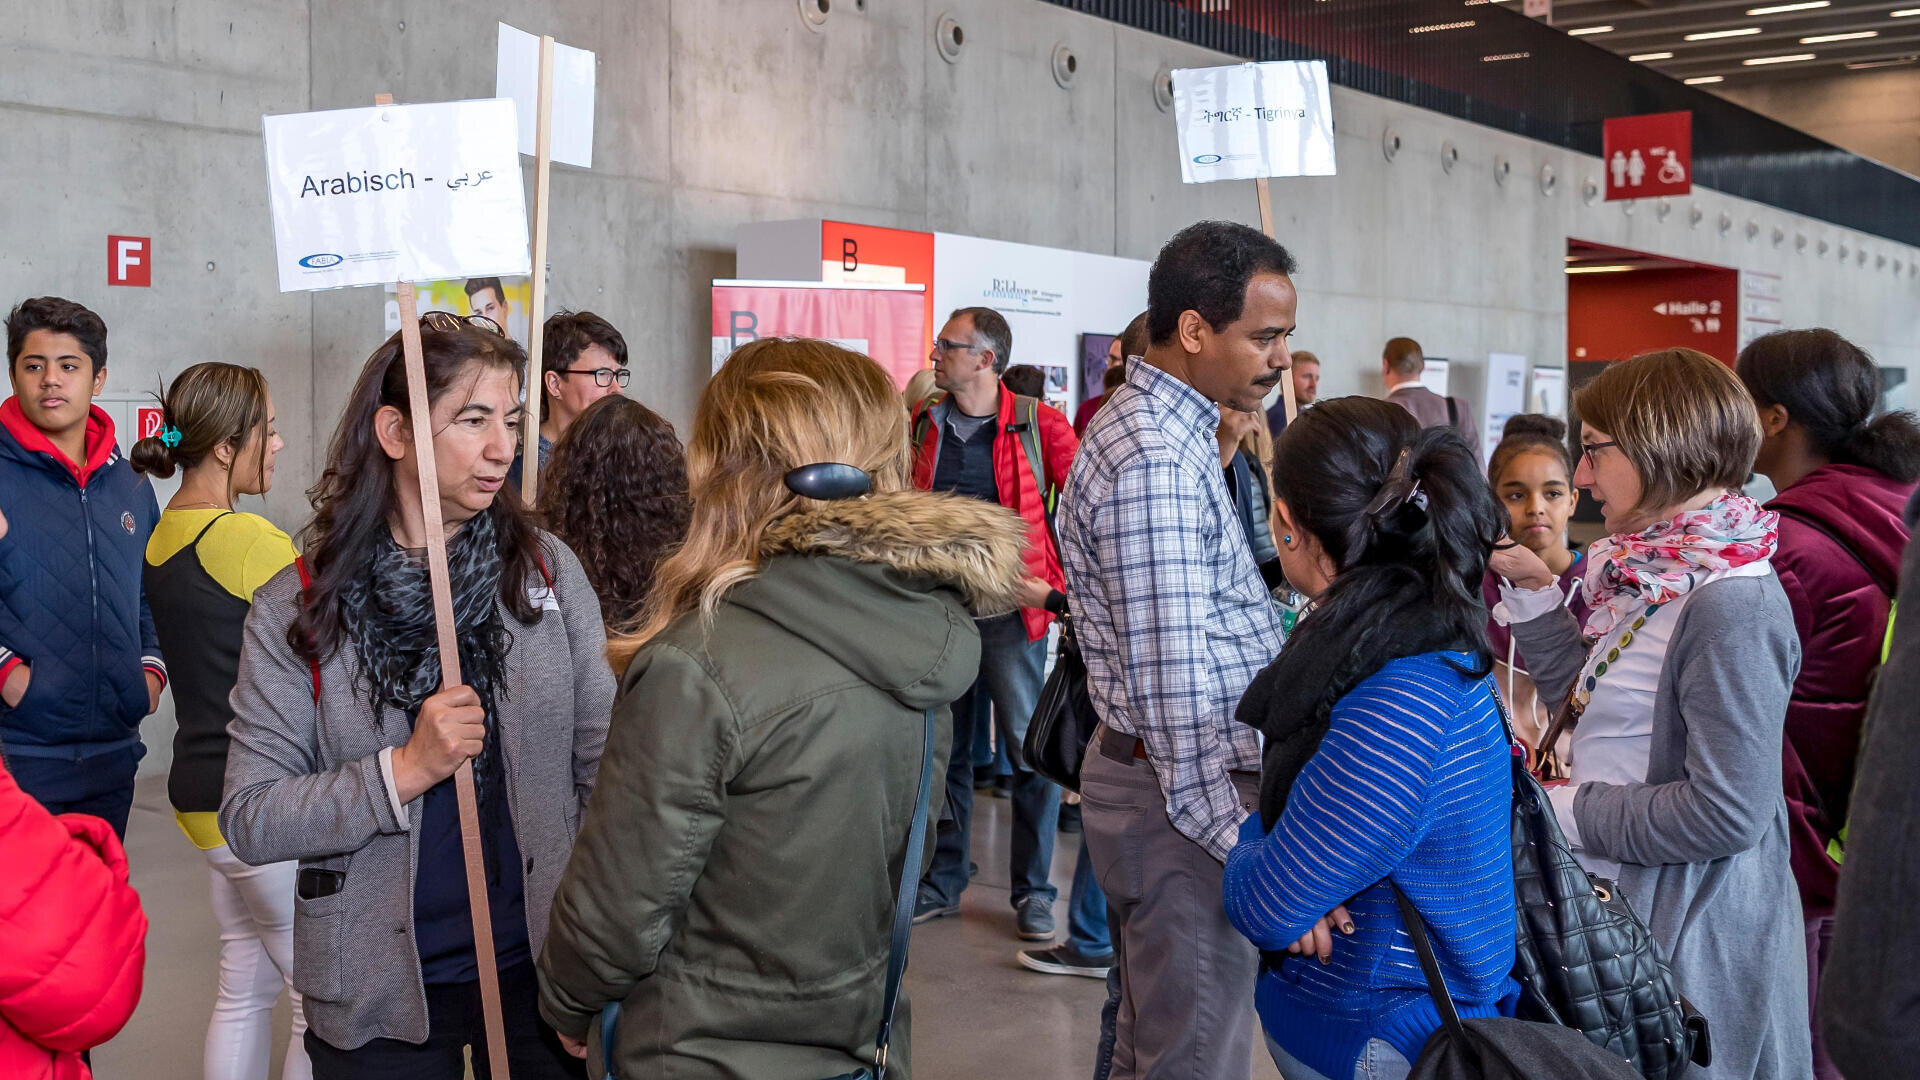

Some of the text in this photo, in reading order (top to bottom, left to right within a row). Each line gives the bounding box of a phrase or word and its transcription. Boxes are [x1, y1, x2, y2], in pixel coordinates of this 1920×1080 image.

[1254, 107, 1305, 121] Tigrinya
[300, 167, 415, 198] Arabisch
[446, 169, 494, 192] عربي
[117, 239, 143, 281] F
[842, 238, 858, 272] B
[1668, 300, 1721, 315] Halle 2
